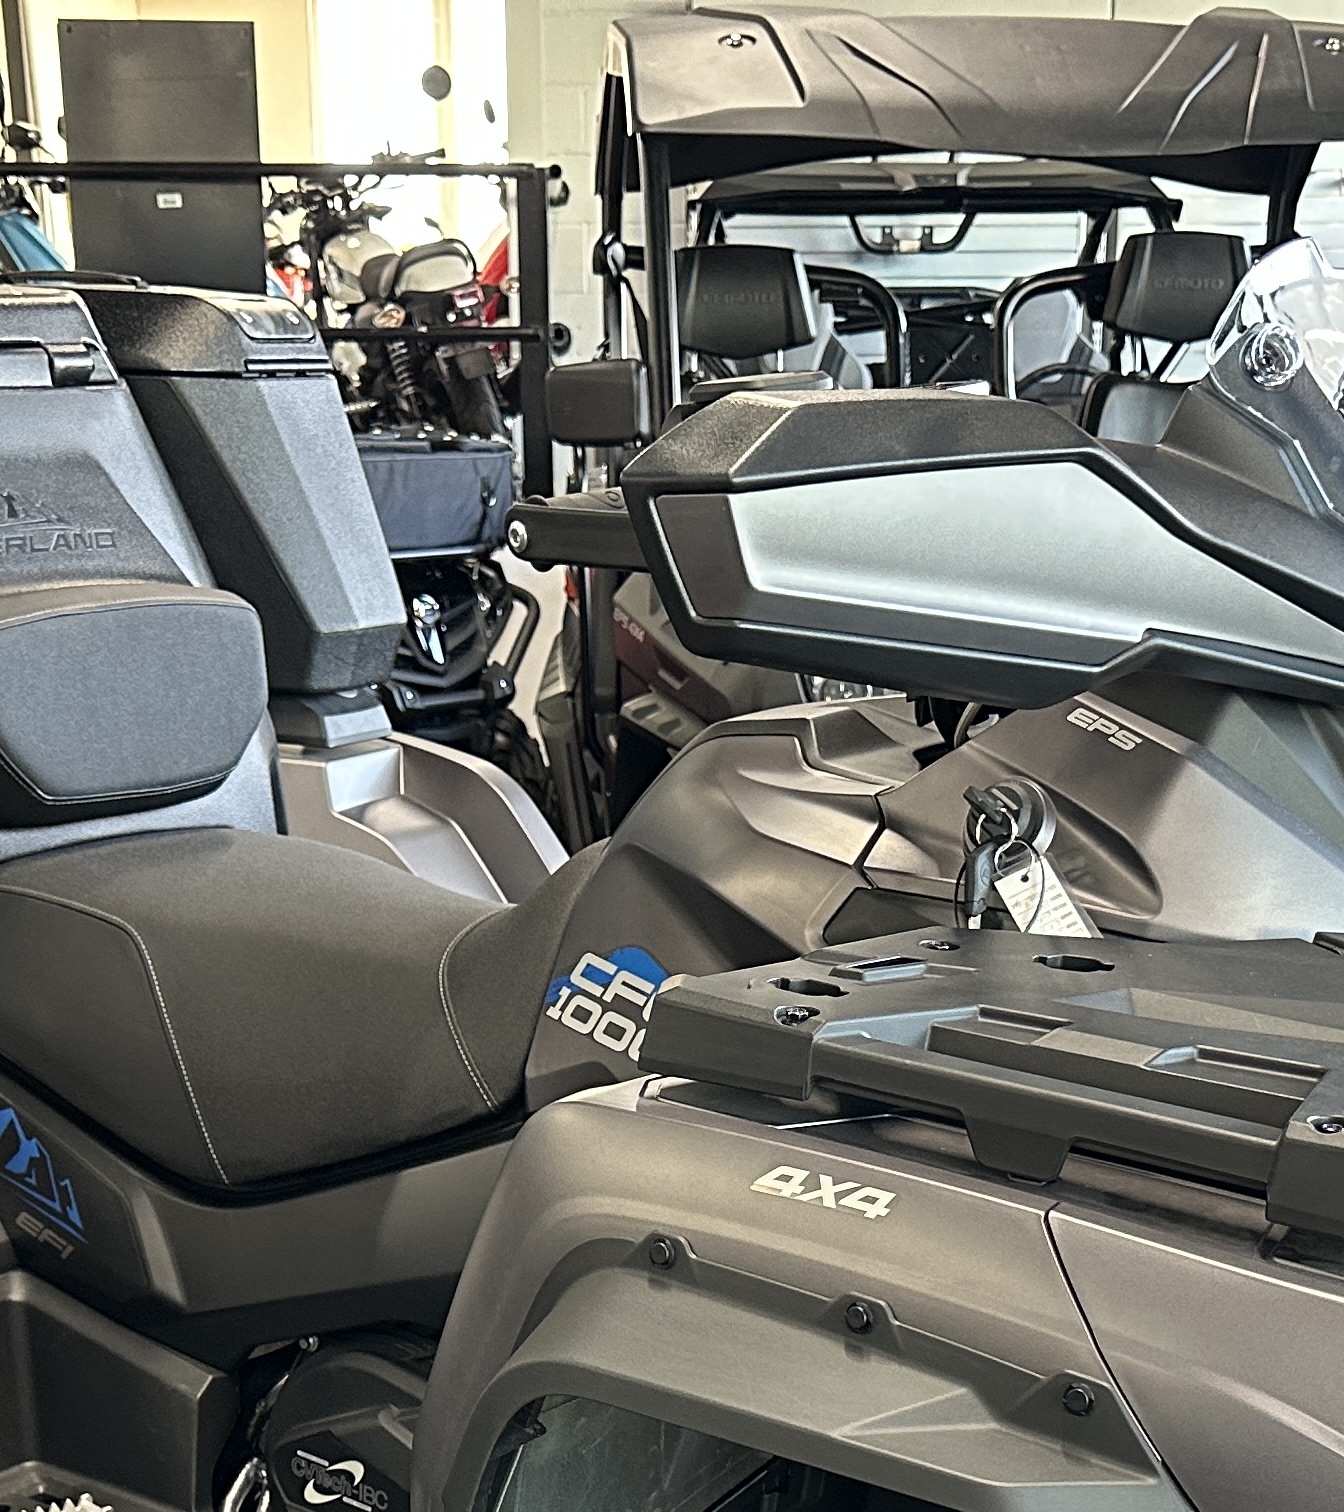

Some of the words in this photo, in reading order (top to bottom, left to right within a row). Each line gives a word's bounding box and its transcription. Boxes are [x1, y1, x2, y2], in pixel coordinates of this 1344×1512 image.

[1066, 707, 1143, 751] EPS
[750, 1165, 897, 1220] 4X4
[15, 1211, 75, 1260] EFI
[291, 1456, 389, 1511] CVTech-IBC
